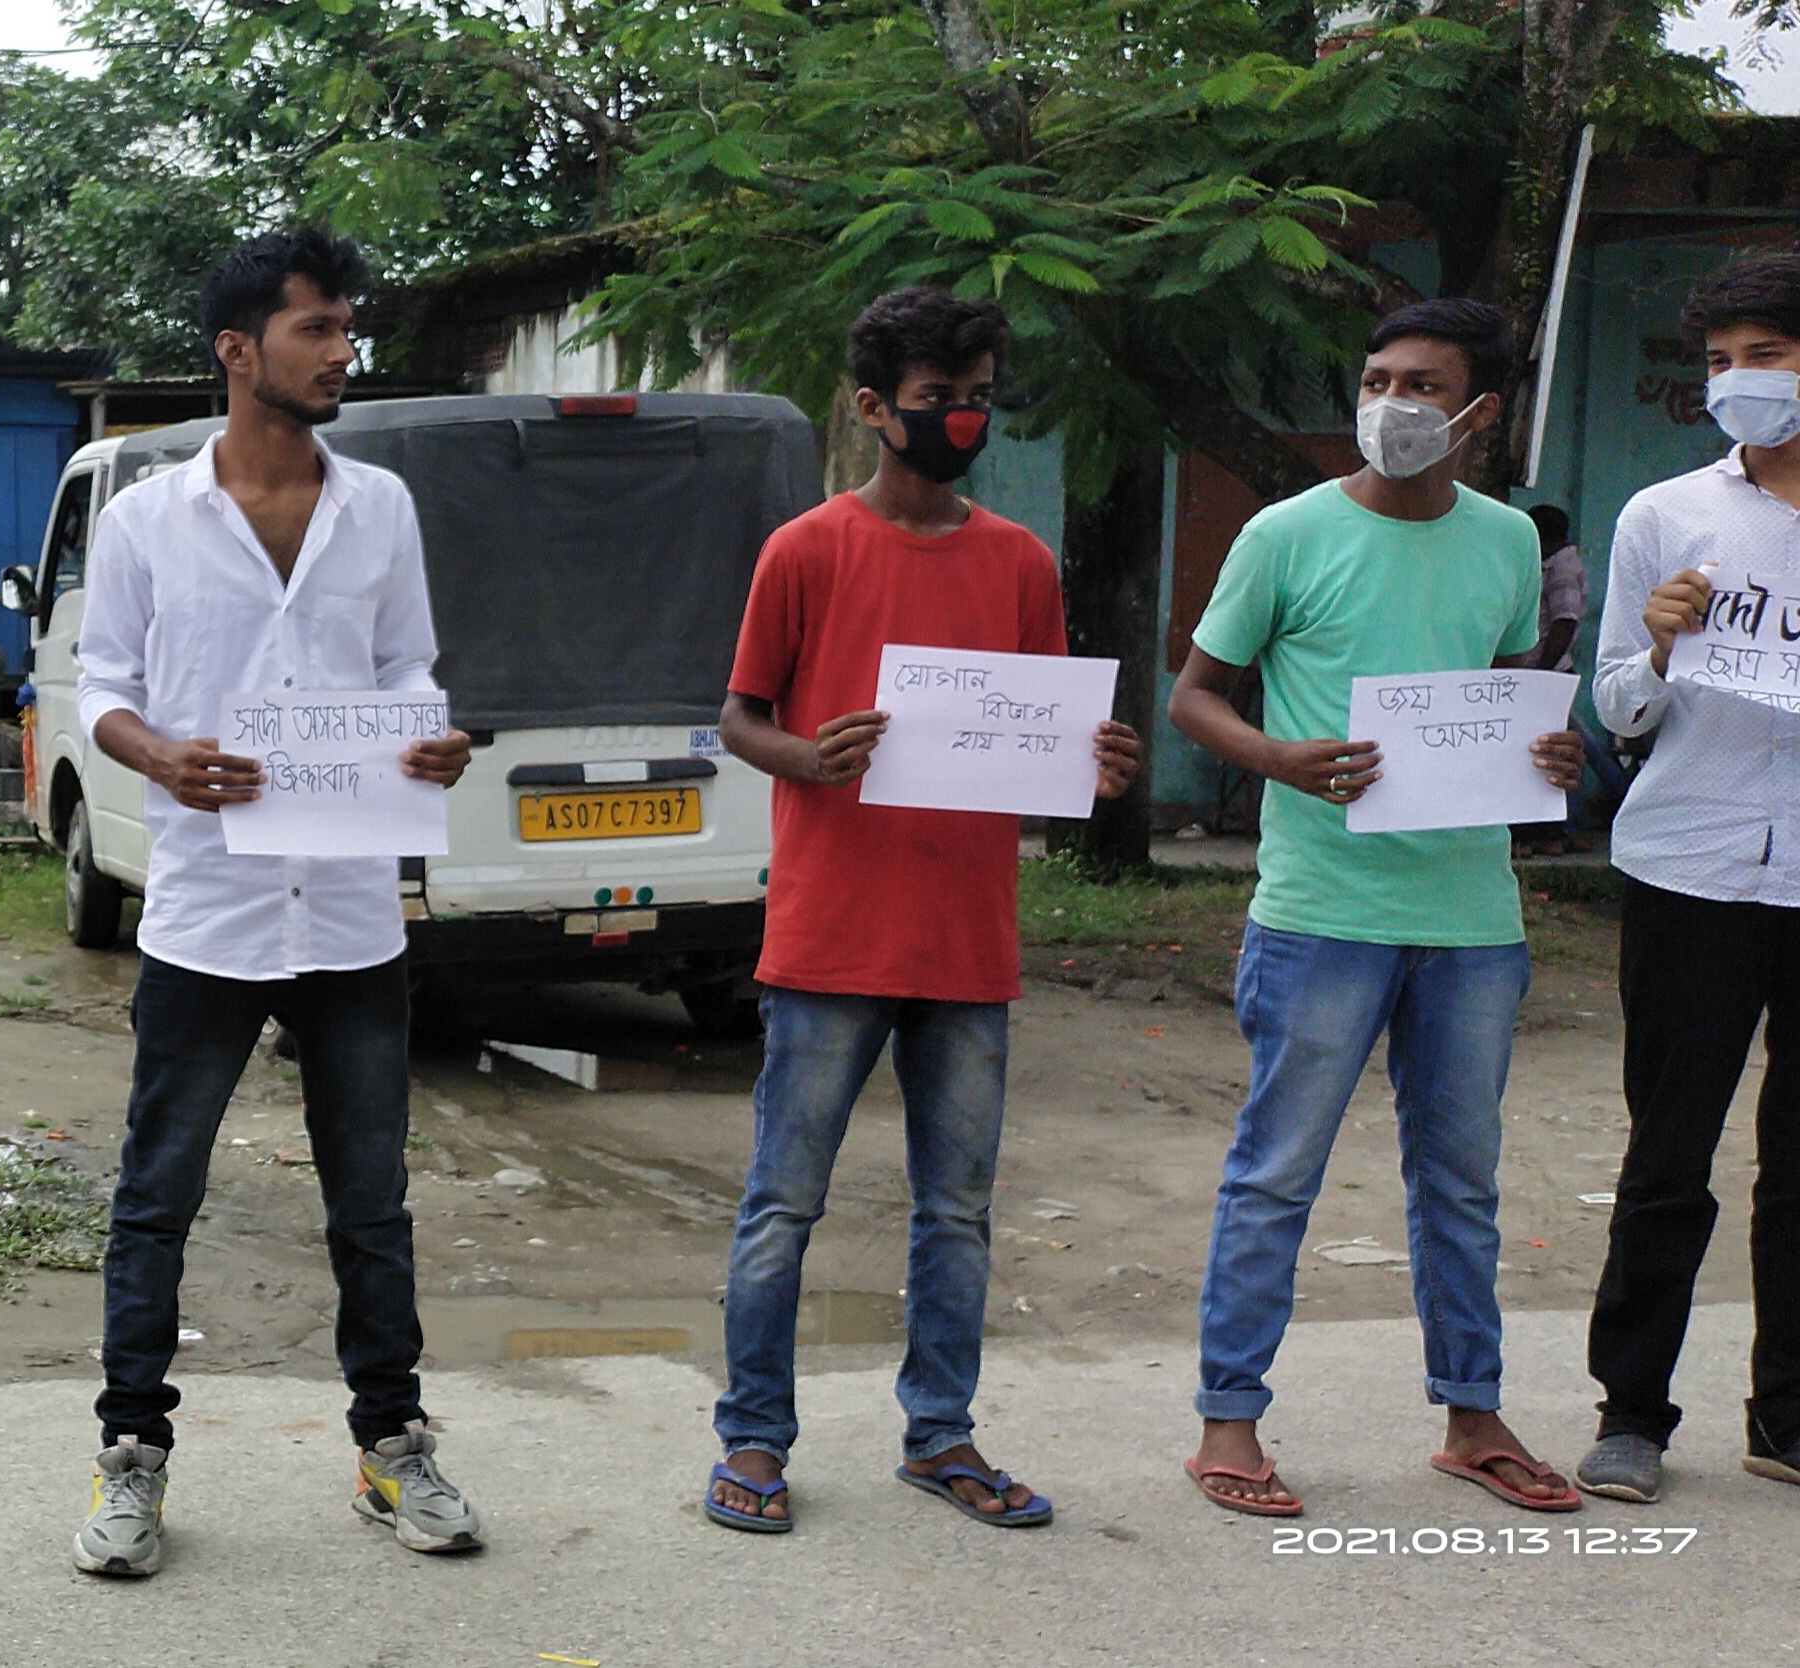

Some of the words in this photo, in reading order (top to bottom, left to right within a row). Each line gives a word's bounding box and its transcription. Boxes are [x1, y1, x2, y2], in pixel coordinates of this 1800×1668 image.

[1459, 674, 1521, 705] আই
[1413, 718, 1513, 750] অসম
[545, 798, 687, 832] AS07C7397
